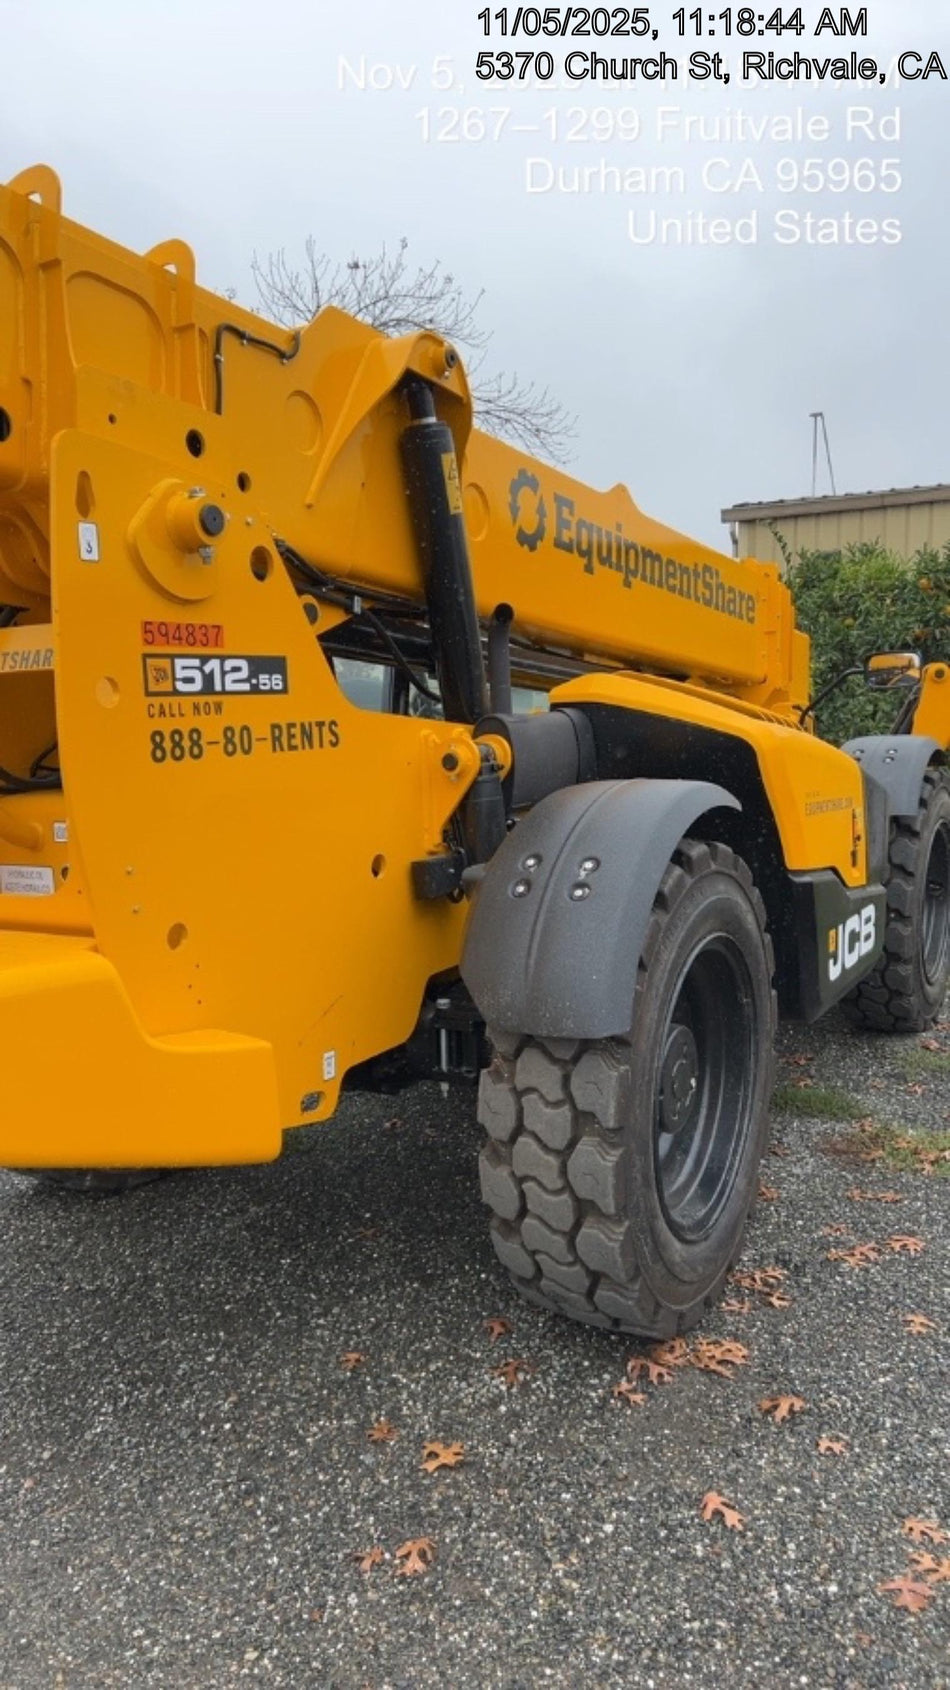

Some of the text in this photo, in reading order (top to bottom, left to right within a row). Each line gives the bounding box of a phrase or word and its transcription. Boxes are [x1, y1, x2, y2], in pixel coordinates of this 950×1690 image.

[553, 491, 757, 624] EquipmentShare
[143, 621, 223, 647] 594837
[173, 657, 283, 692] 512-56
[147, 701, 224, 718] CALL NOW
[150, 719, 341, 764] 888-80-RENTS
[828, 903, 876, 982] JCB
